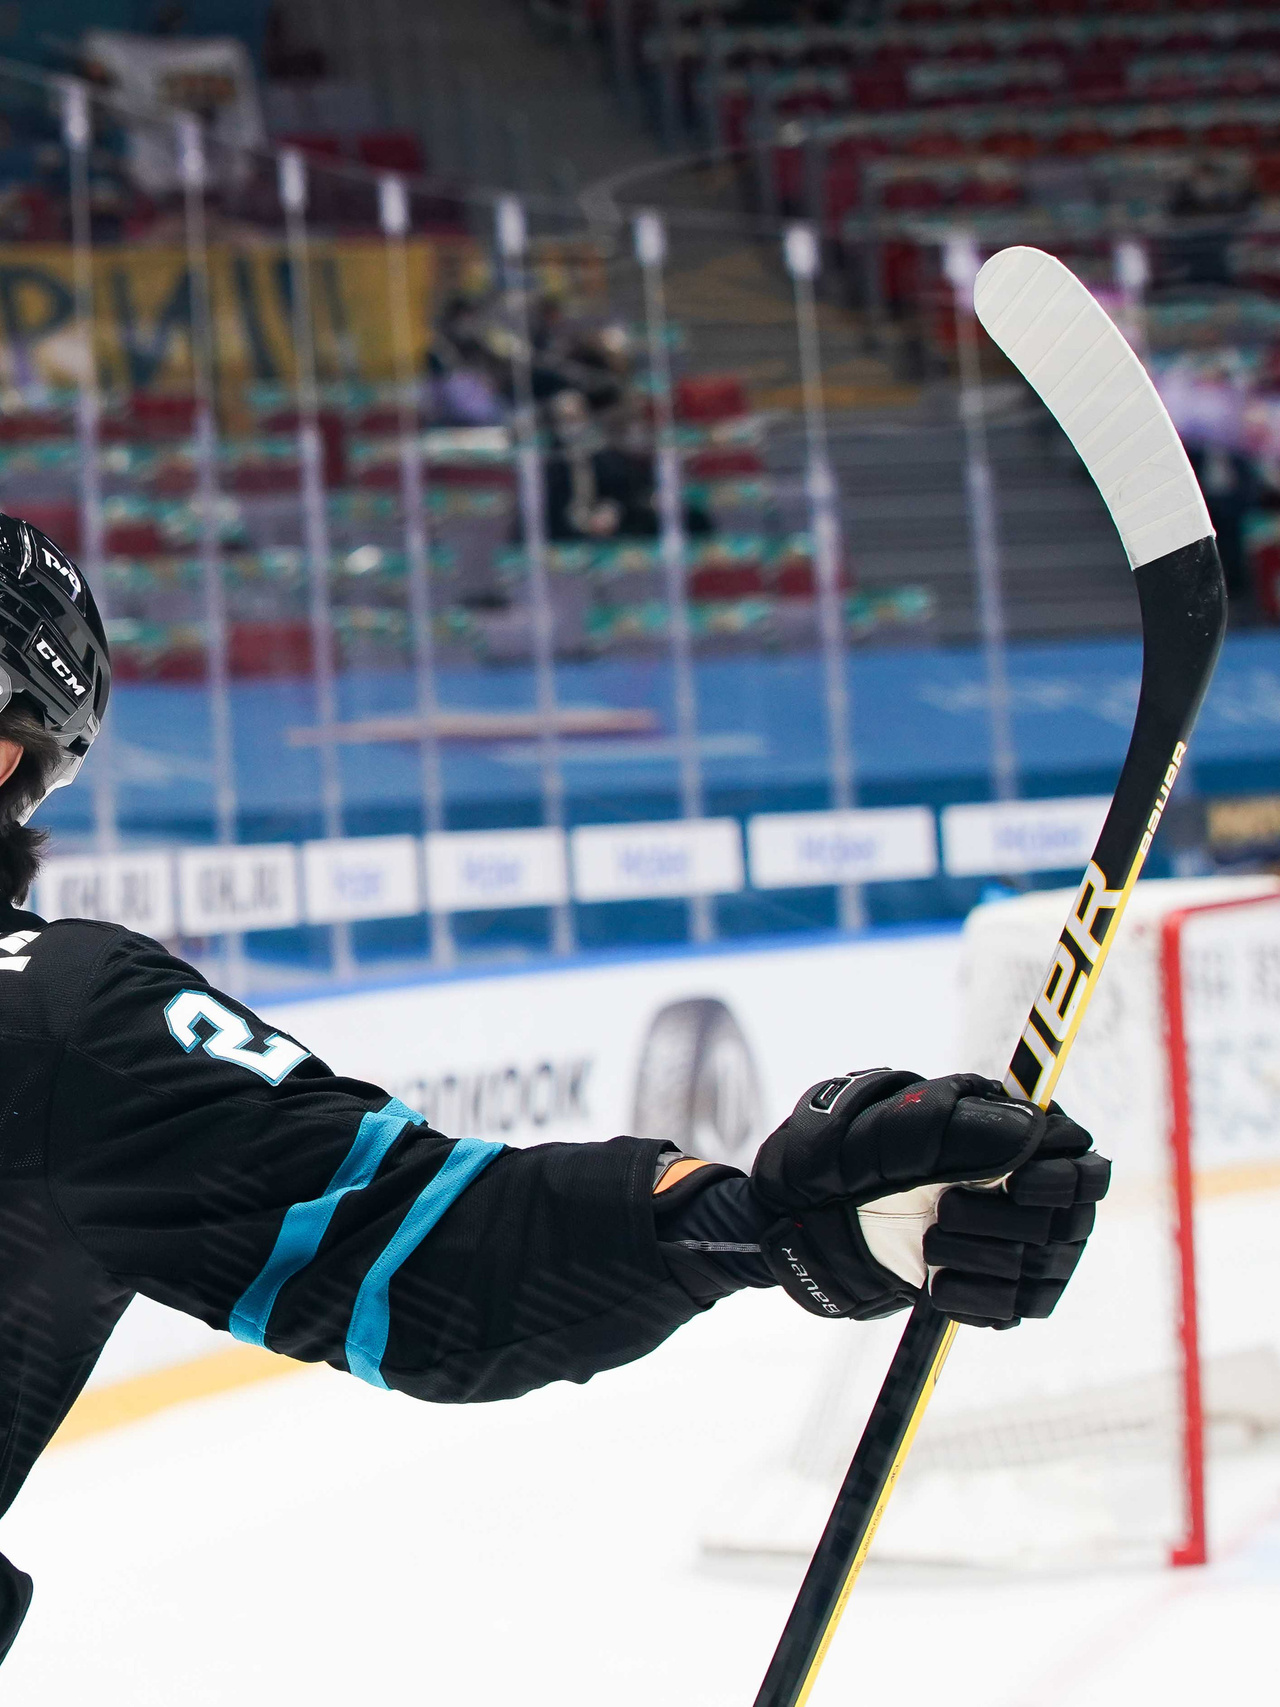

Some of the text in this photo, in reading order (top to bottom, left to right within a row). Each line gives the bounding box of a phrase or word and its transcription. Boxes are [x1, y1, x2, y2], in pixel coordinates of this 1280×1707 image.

[35, 636, 87, 698] CCM
[1138, 740, 1188, 856] BAUER
[1002, 859, 1125, 1104] UER
[781, 1246, 841, 1315] BAUER
